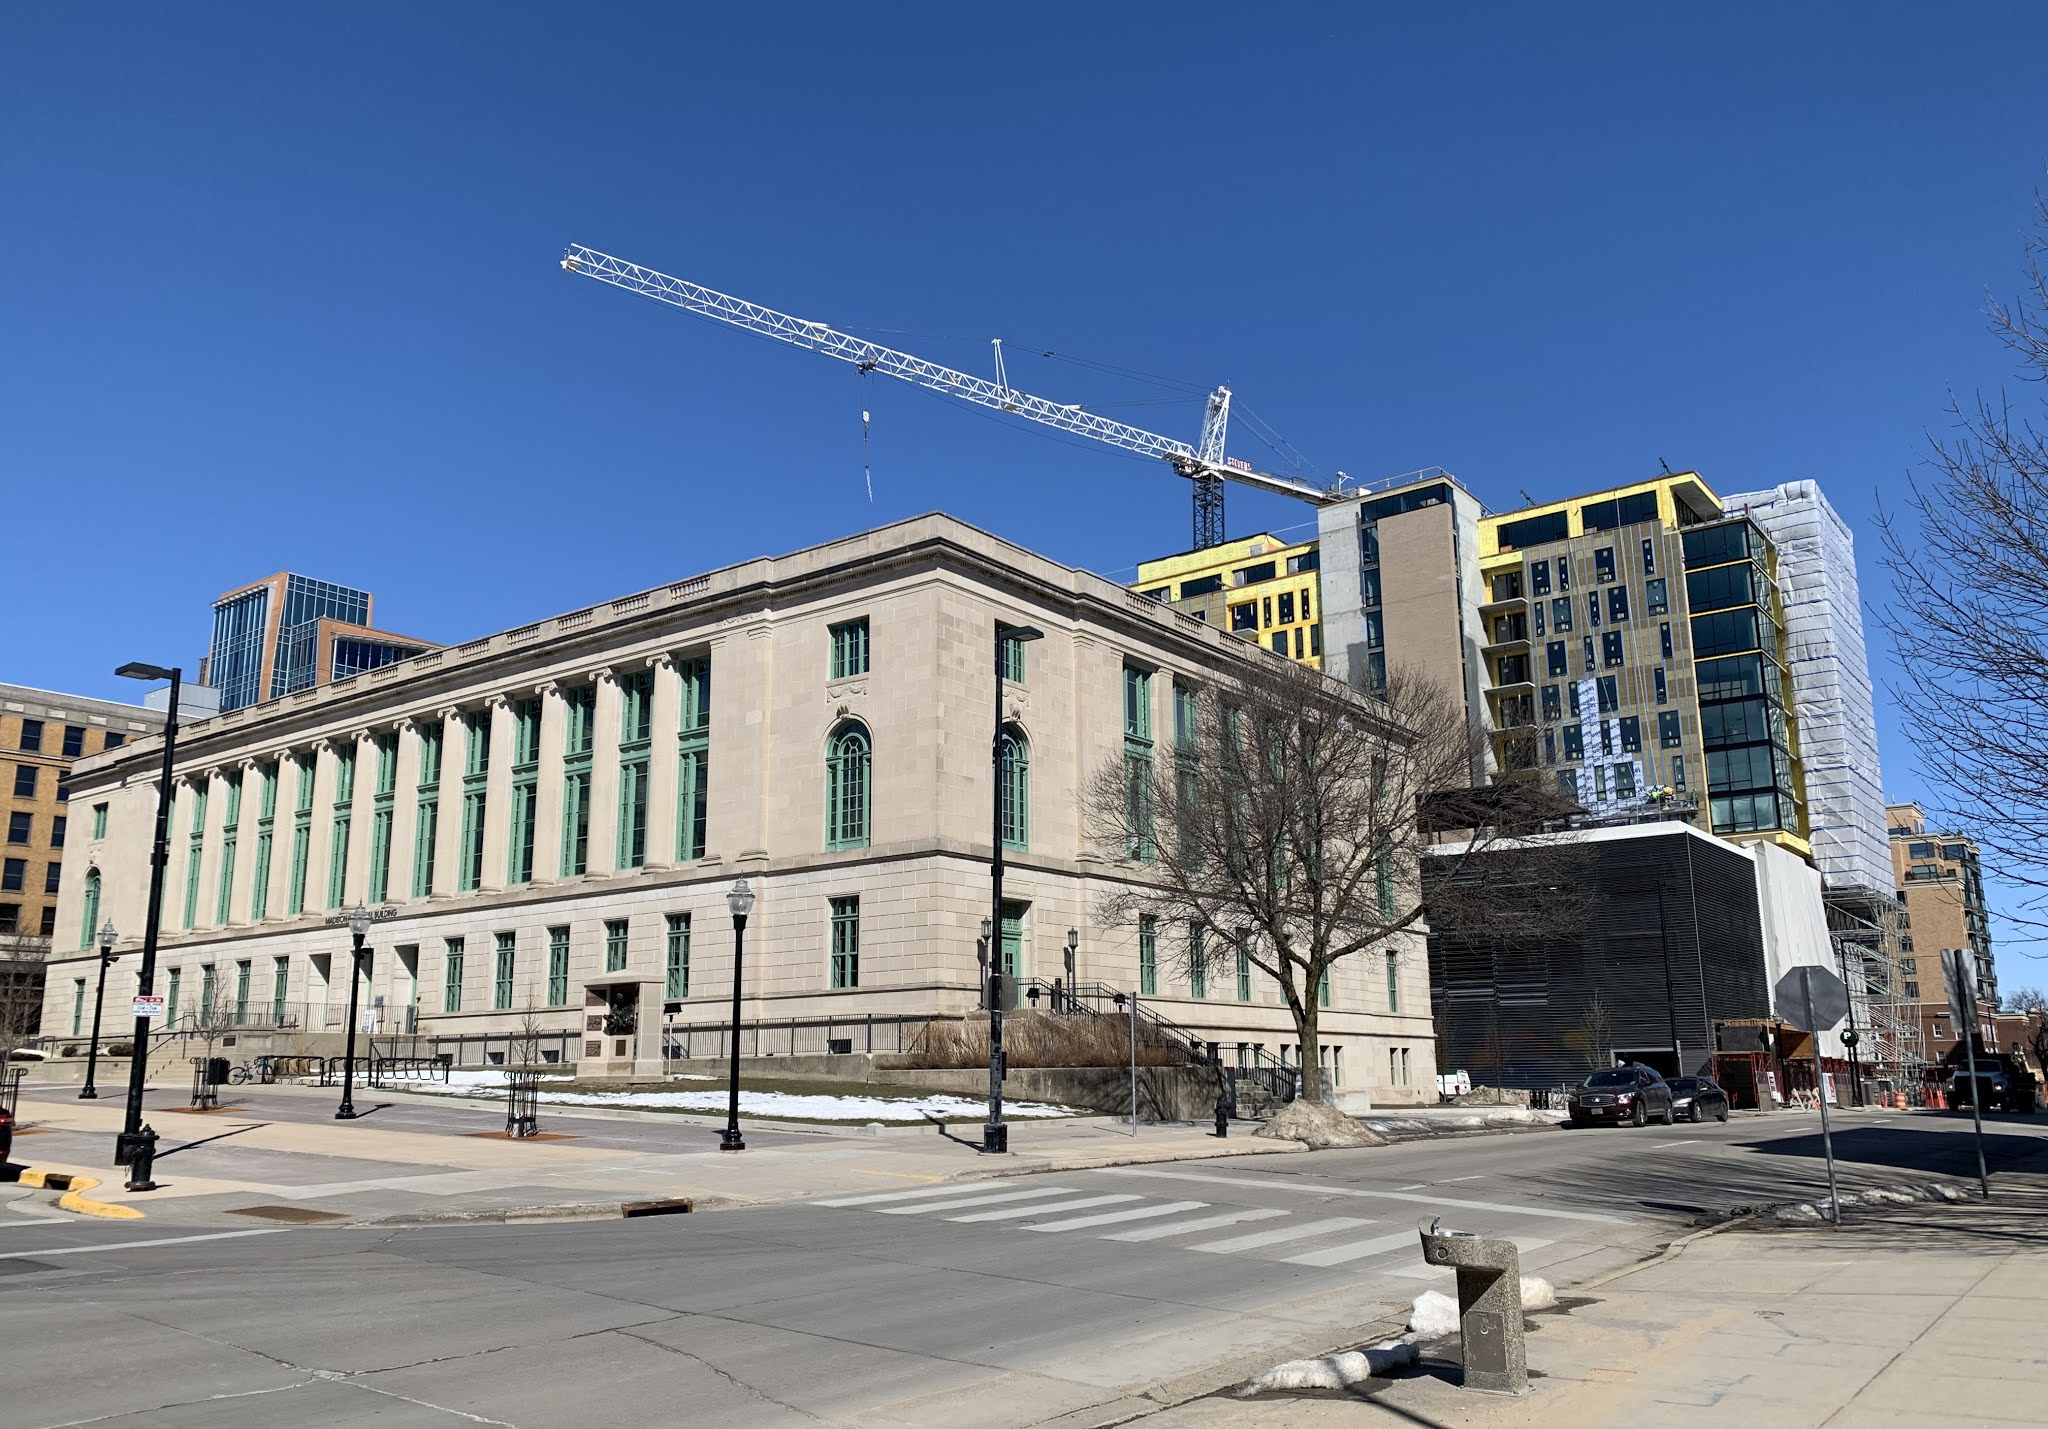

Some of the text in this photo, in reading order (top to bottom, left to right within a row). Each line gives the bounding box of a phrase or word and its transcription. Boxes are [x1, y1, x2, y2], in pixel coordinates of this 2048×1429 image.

[325, 915, 347, 924] MADISON
[375, 909, 397, 918] BUILDING
[1844, 1031, 1851, 1039] P
